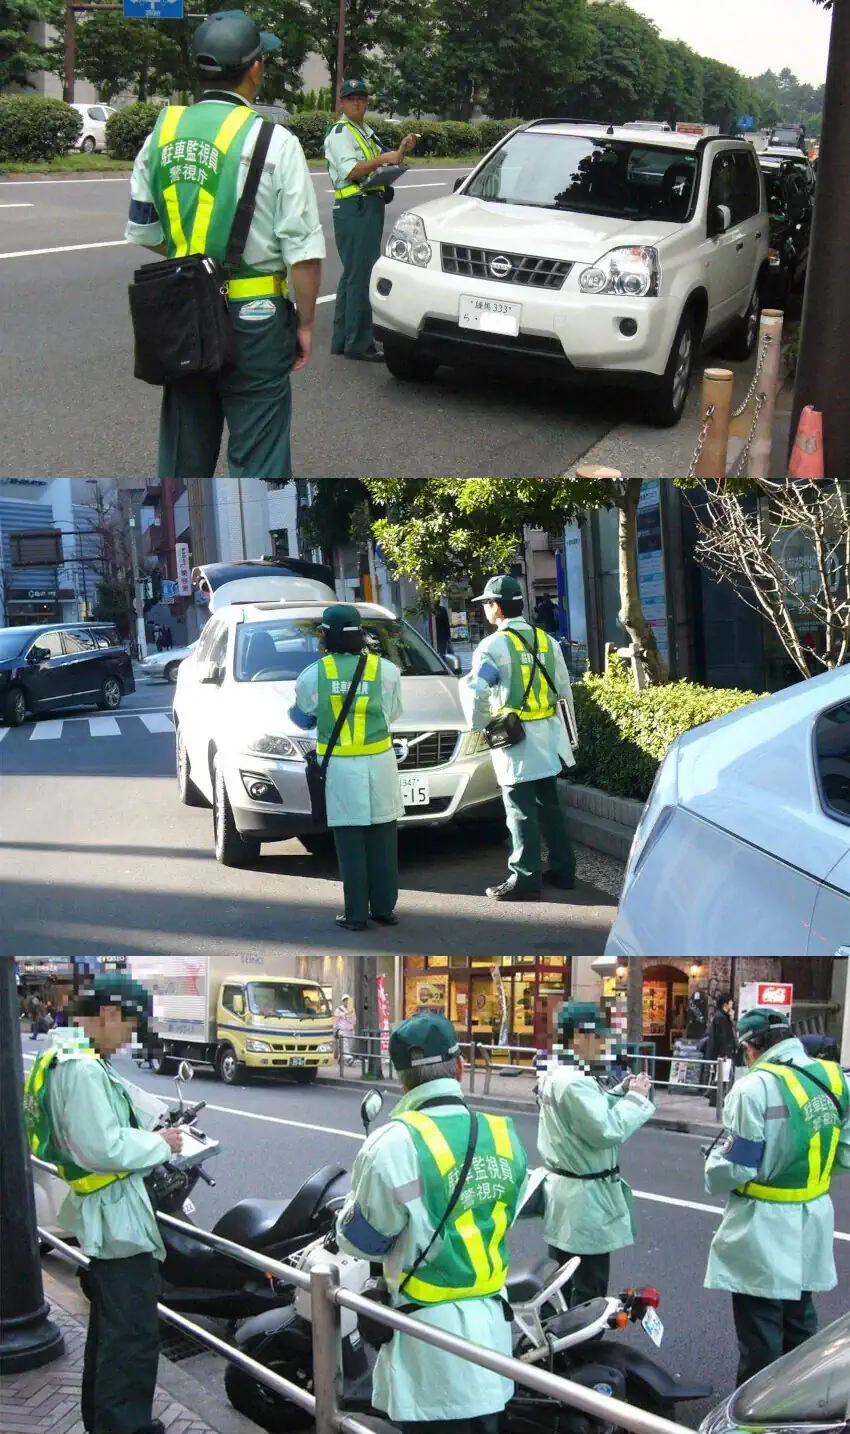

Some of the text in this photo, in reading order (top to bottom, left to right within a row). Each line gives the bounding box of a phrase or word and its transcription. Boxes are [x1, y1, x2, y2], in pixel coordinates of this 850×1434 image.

[161, 140, 219, 174] 駐車監視員
[169, 165, 208, 185] 警視庁
